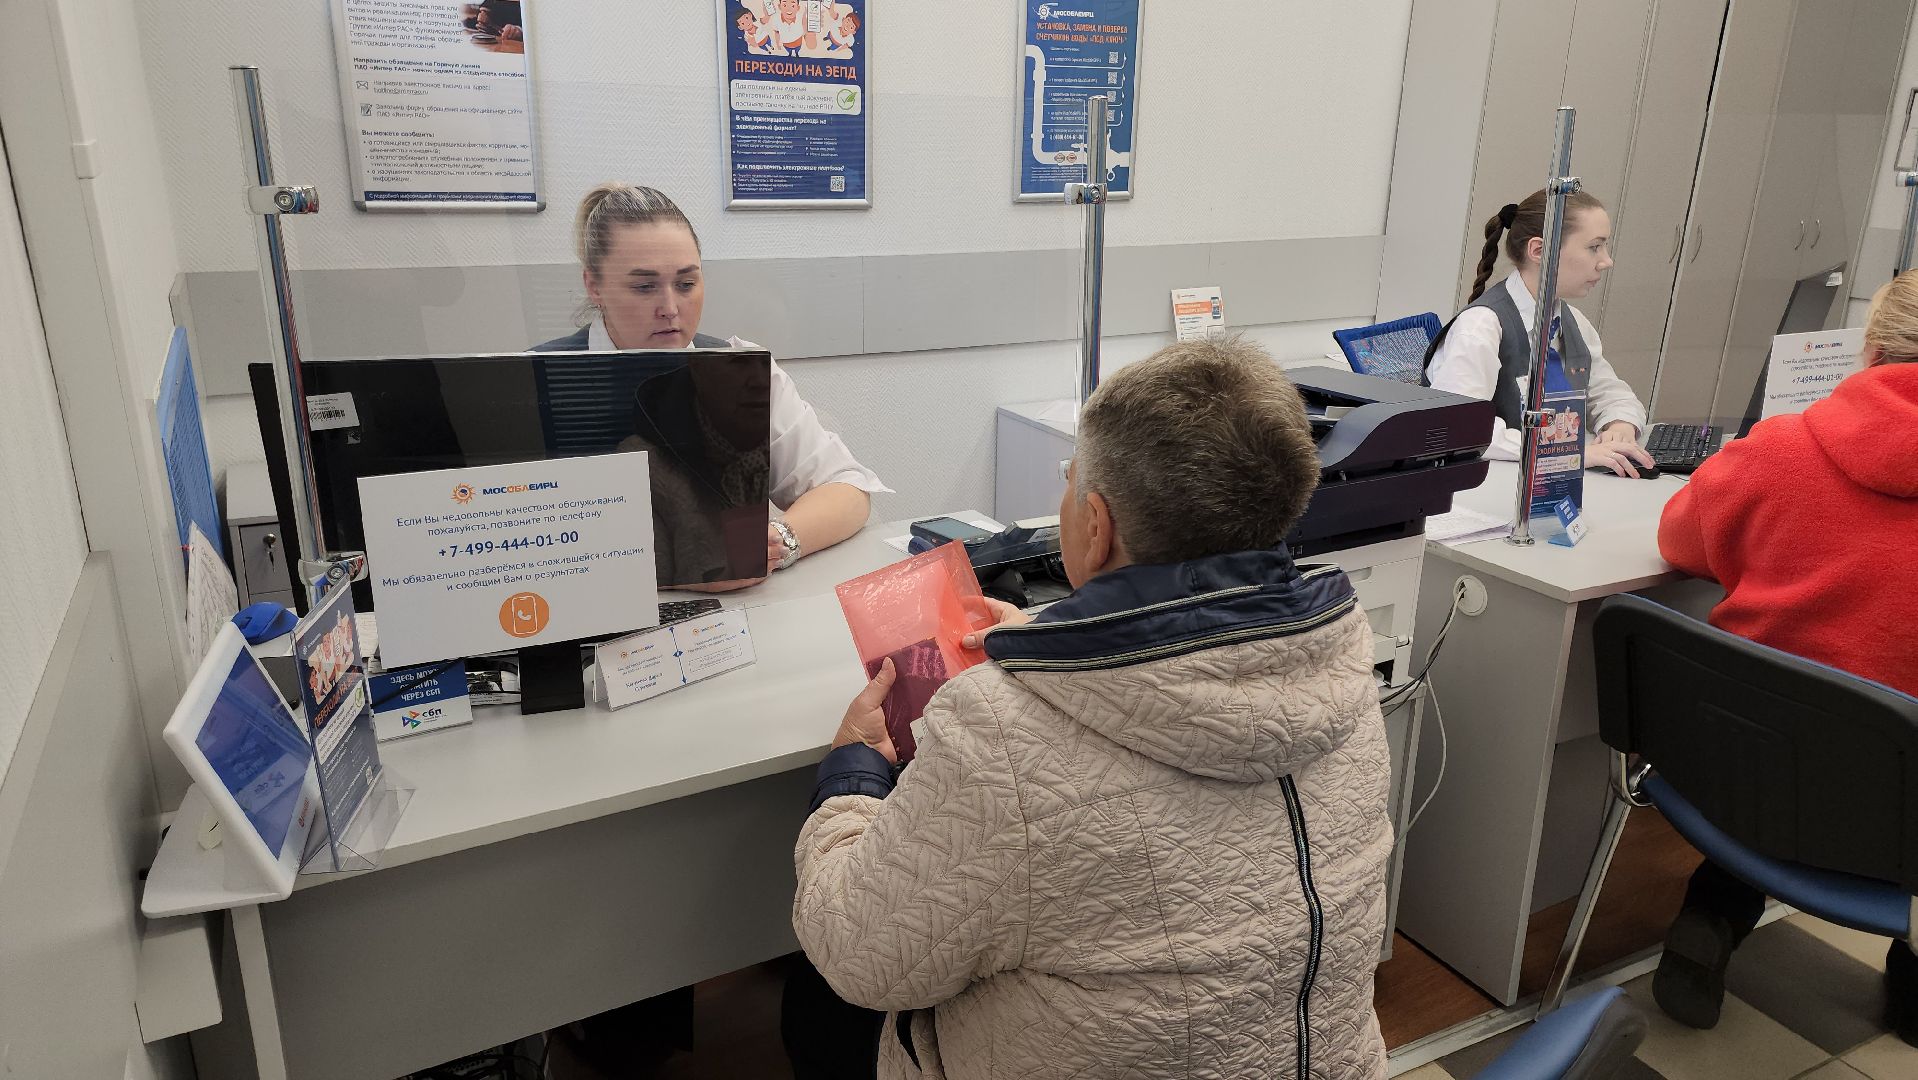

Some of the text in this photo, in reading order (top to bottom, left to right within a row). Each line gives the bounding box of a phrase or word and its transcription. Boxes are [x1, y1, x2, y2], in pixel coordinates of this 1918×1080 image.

[736, 60, 857, 81] ПЕРЕХОДИ НА ЭЕПД
[483, 481, 558, 496] МОСОБЛЕИРЦ
[397, 495, 626, 527] Если Вы недовольны качеством обслуживания,
[428, 522, 490, 536] пожалуйста,
[490, 517, 540, 529] позвоните
[560, 510, 602, 522] телефону
[382, 578, 400, 586] Мы
[402, 570, 466, 584] обязательно
[468, 562, 526, 578] разберёмся
[536, 552, 600, 567] сложившейся
[602, 547, 644, 558] ситуации
[456, 579, 500, 590] сообщим
[503, 574, 523, 584] Вам
[534, 566, 590, 582] результатах
[390, 673, 415, 684] ЗДЕСЬ
[401, 688, 440, 702] ЧЕРЕЗ СБП
